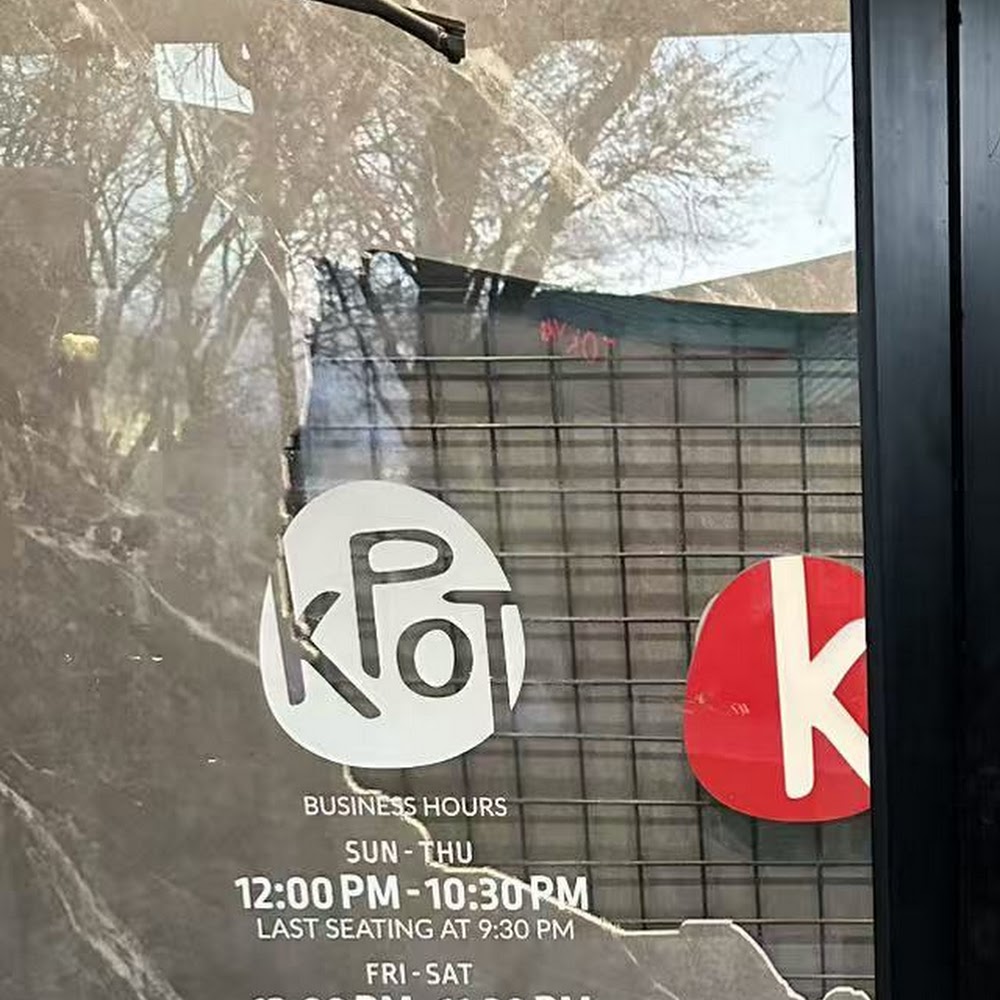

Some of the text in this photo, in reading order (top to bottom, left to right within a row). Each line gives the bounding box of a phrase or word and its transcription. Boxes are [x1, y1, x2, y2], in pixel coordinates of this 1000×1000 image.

[272, 528, 517, 730] KPOT
[303, 796, 508, 817] BUSINESS HOURS
[345, 840, 399, 864] SUN
[418, 840, 473, 864] THU
[234, 876, 334, 910] 12:00
[340, 874, 400, 910] PM
[424, 876, 523, 911] 10:30
[530, 874, 588, 911] PM
[256, 917, 574, 940] LAST SEATING AT 9:30 PM
[366, 963, 406, 985] FRI
[425, 963, 473, 985] SAT
